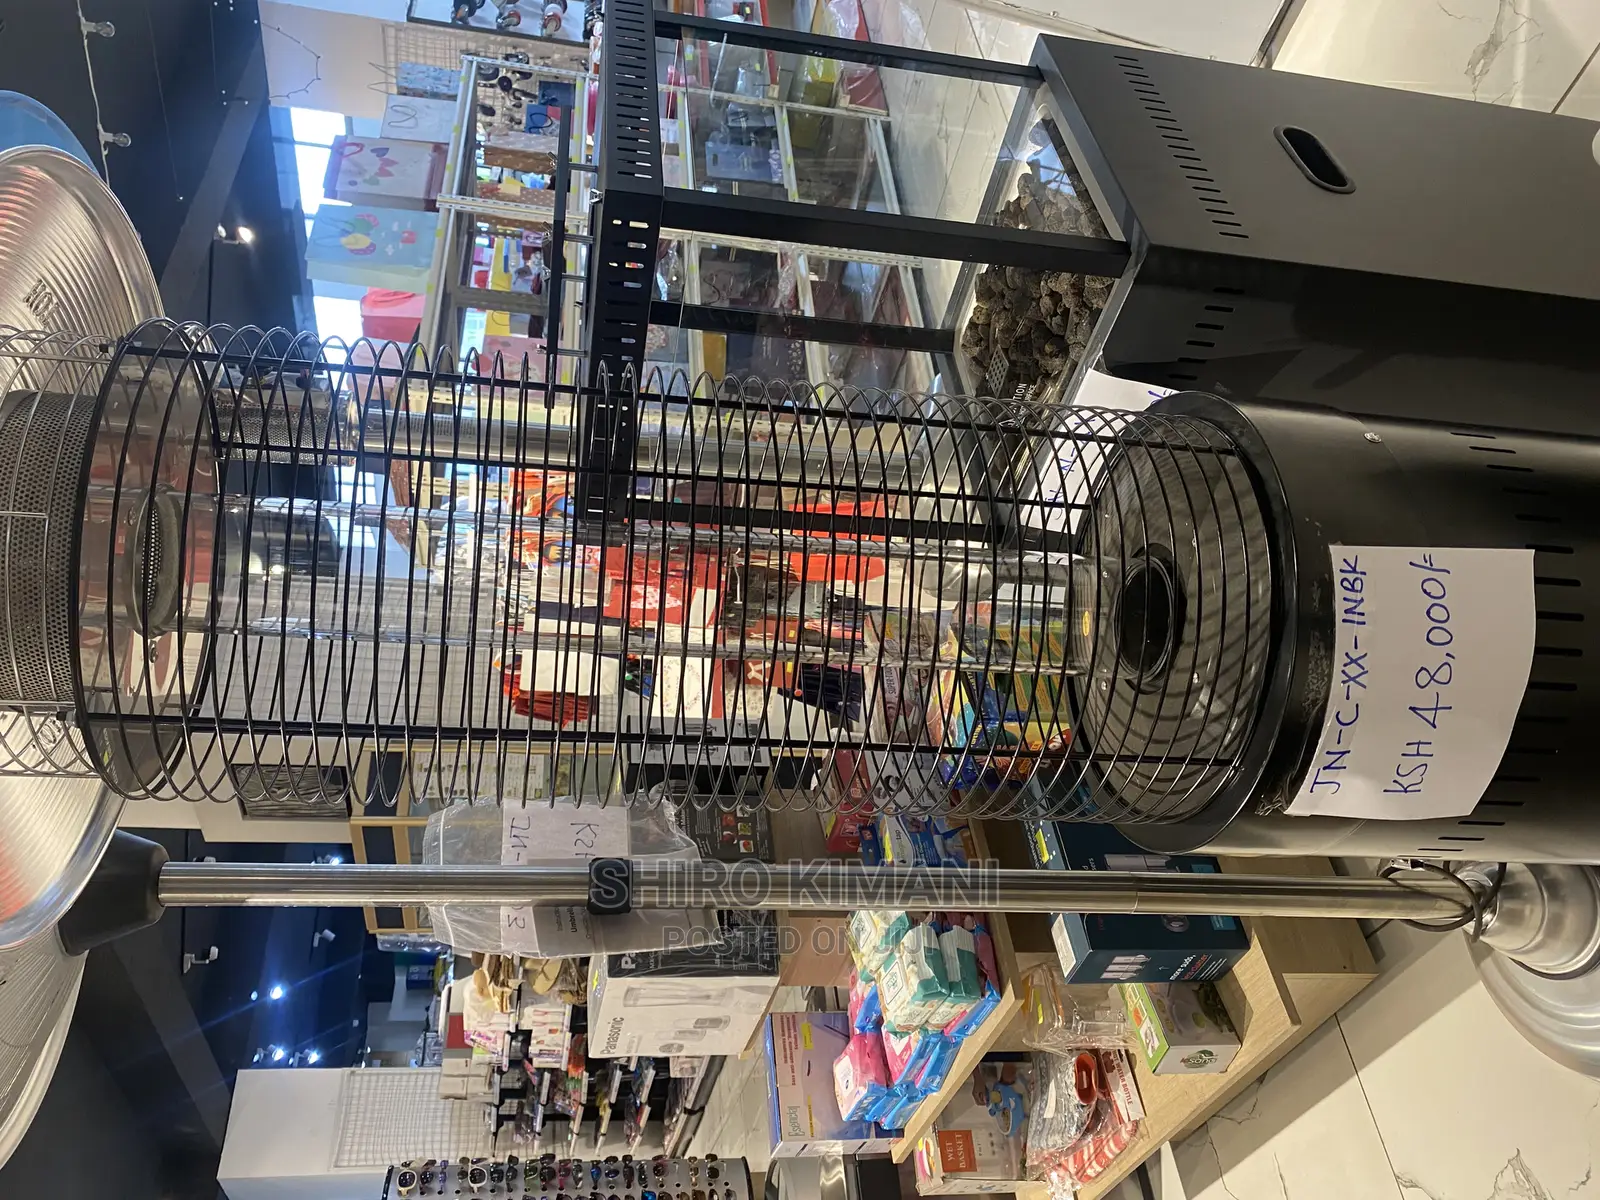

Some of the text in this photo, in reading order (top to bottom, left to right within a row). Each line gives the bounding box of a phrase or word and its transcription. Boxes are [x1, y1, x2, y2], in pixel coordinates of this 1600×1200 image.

[1382, 739, 1435, 796] KSH
[600, 1016, 625, 1055] Panasonic
[1115, 1063, 1126, 1083] WATER
[1121, 1083, 1134, 1105] BOTTLE
[944, 1139, 955, 1162] WET
[954, 1131, 967, 1169] BASKET
